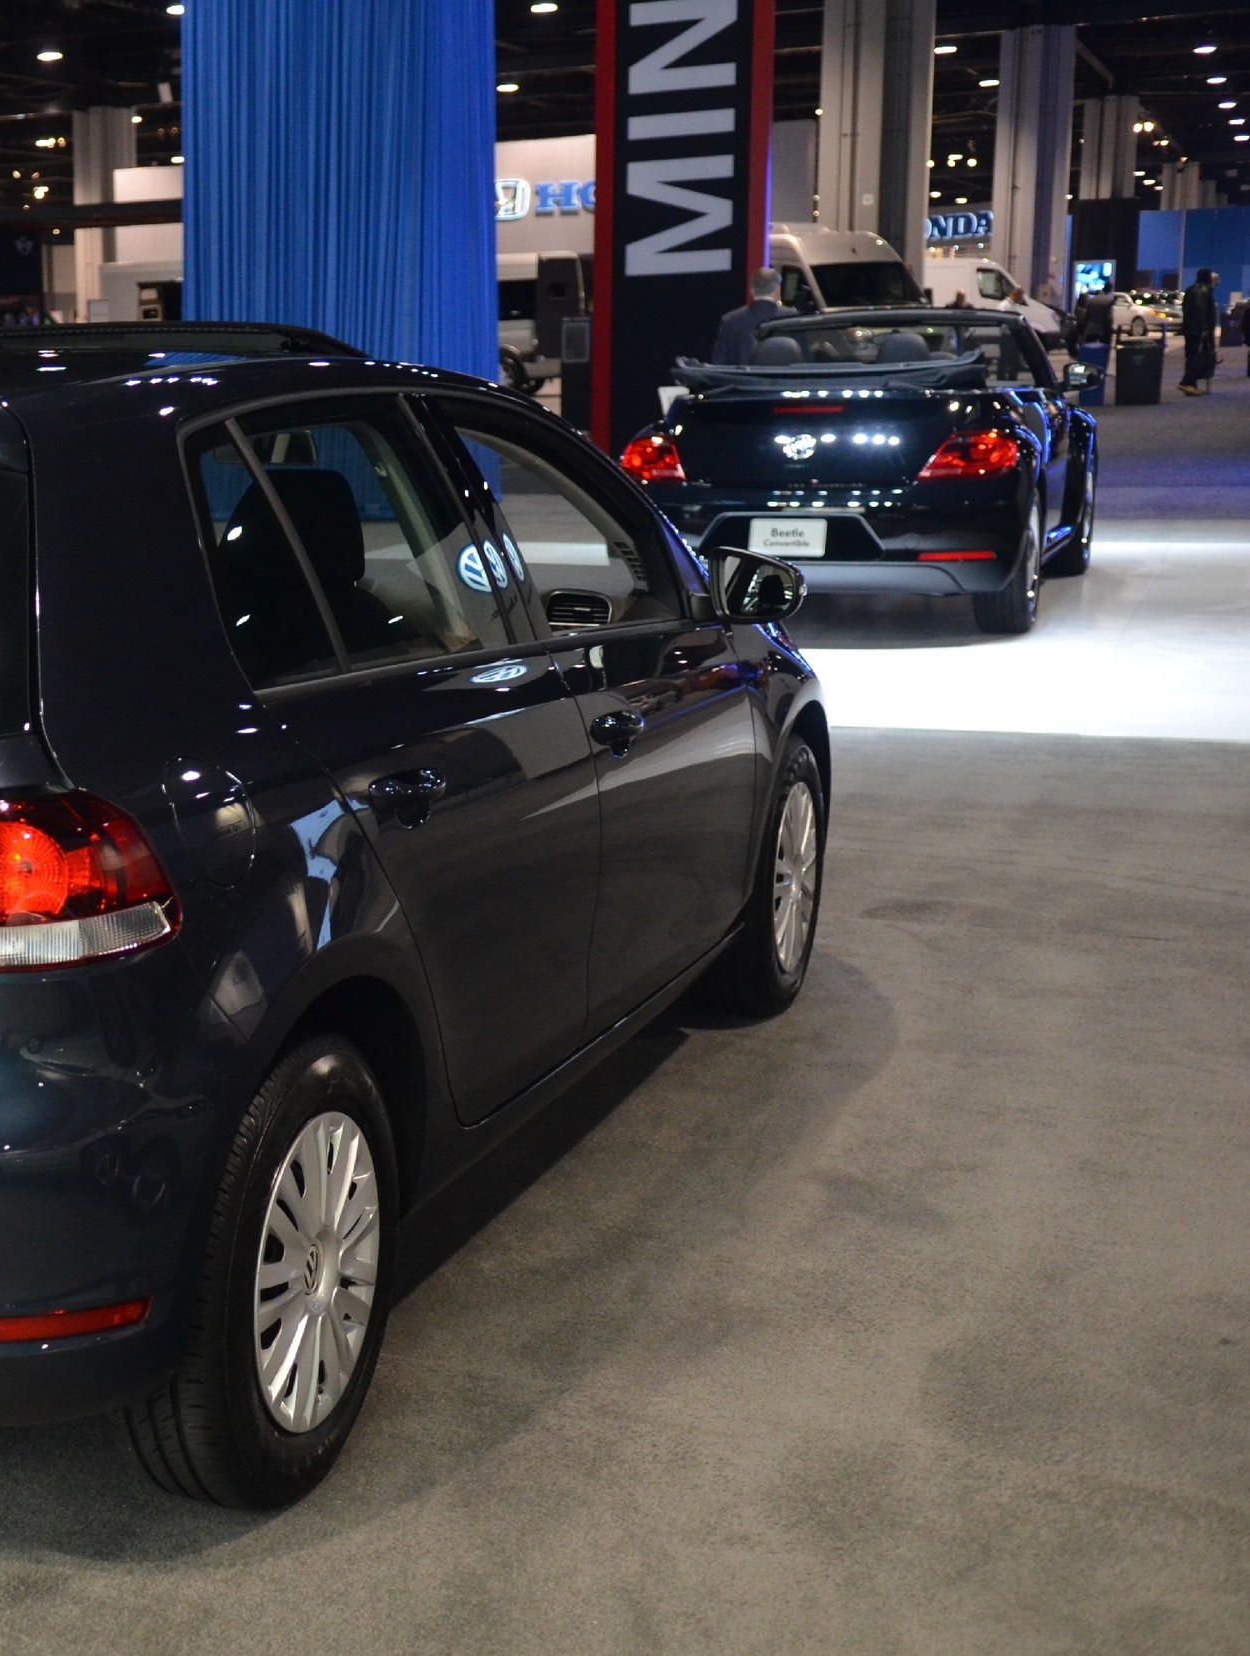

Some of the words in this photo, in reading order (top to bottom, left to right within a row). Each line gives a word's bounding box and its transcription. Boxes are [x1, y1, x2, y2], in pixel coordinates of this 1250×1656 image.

[625, 0, 738, 276] MIN
[925, 210, 993, 241] NDA
[763, 538, 811, 548] Convertible
[770, 527, 805, 538] Beetle
